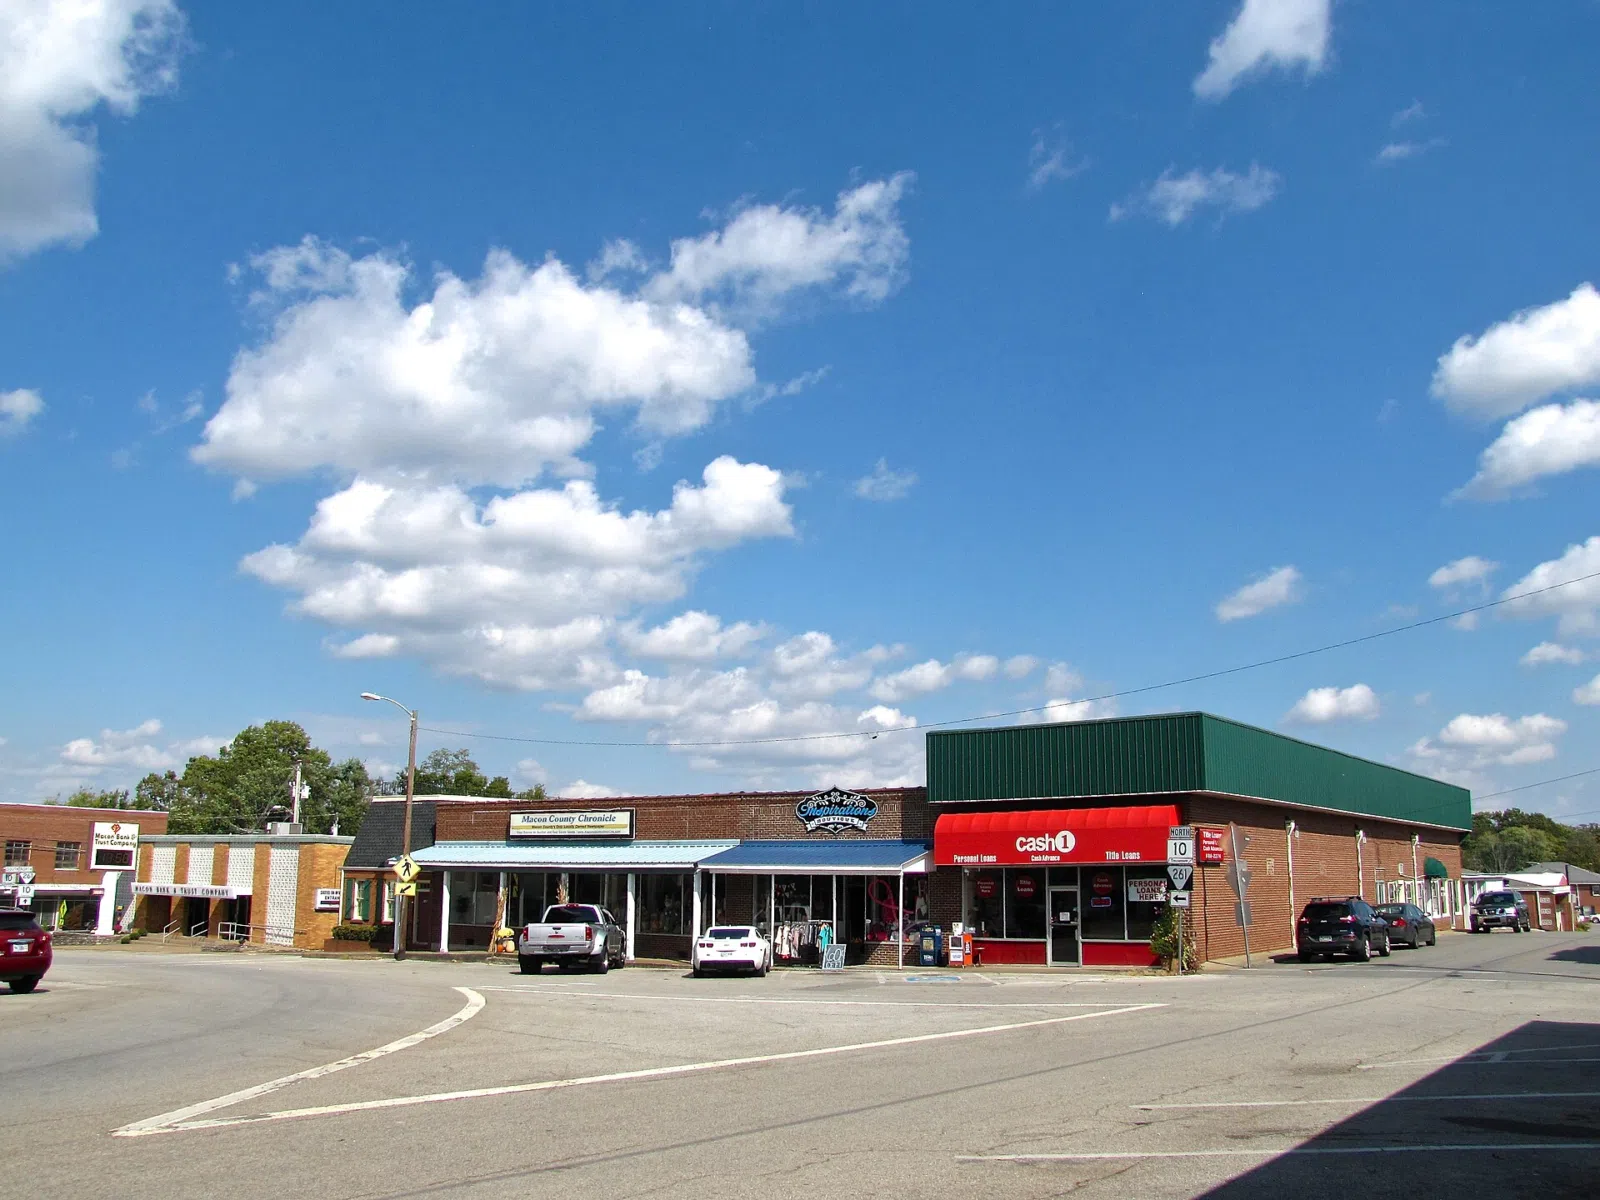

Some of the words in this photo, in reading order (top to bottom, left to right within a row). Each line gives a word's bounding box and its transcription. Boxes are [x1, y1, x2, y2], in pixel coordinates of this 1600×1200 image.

[799, 804, 877, 818] Inspirations
[521, 815, 548, 823] Macon
[548, 814, 576, 824] County
[577, 813, 617, 823] Chronicle
[817, 816, 855, 824] BOUTIQUE
[1170, 827, 1190, 837] NORTH
[110, 840, 137, 849] Company
[1173, 842, 1187, 856] 10
[953, 854, 979, 863] Personal
[980, 854, 997, 863] Loans
[1030, 854, 1042, 862] Cash
[1042, 854, 1060, 862] Advance
[1105, 851, 1120, 860] Title
[1121, 850, 1141, 860] Loans
[5, 873, 13, 882] 10
[1172, 868, 1187, 880] 261
[22, 886, 31, 894] 10
[180, 887, 197, 895] TRUST
[201, 888, 230, 897] COMPANY
[1139, 893, 1159, 901] HERE
